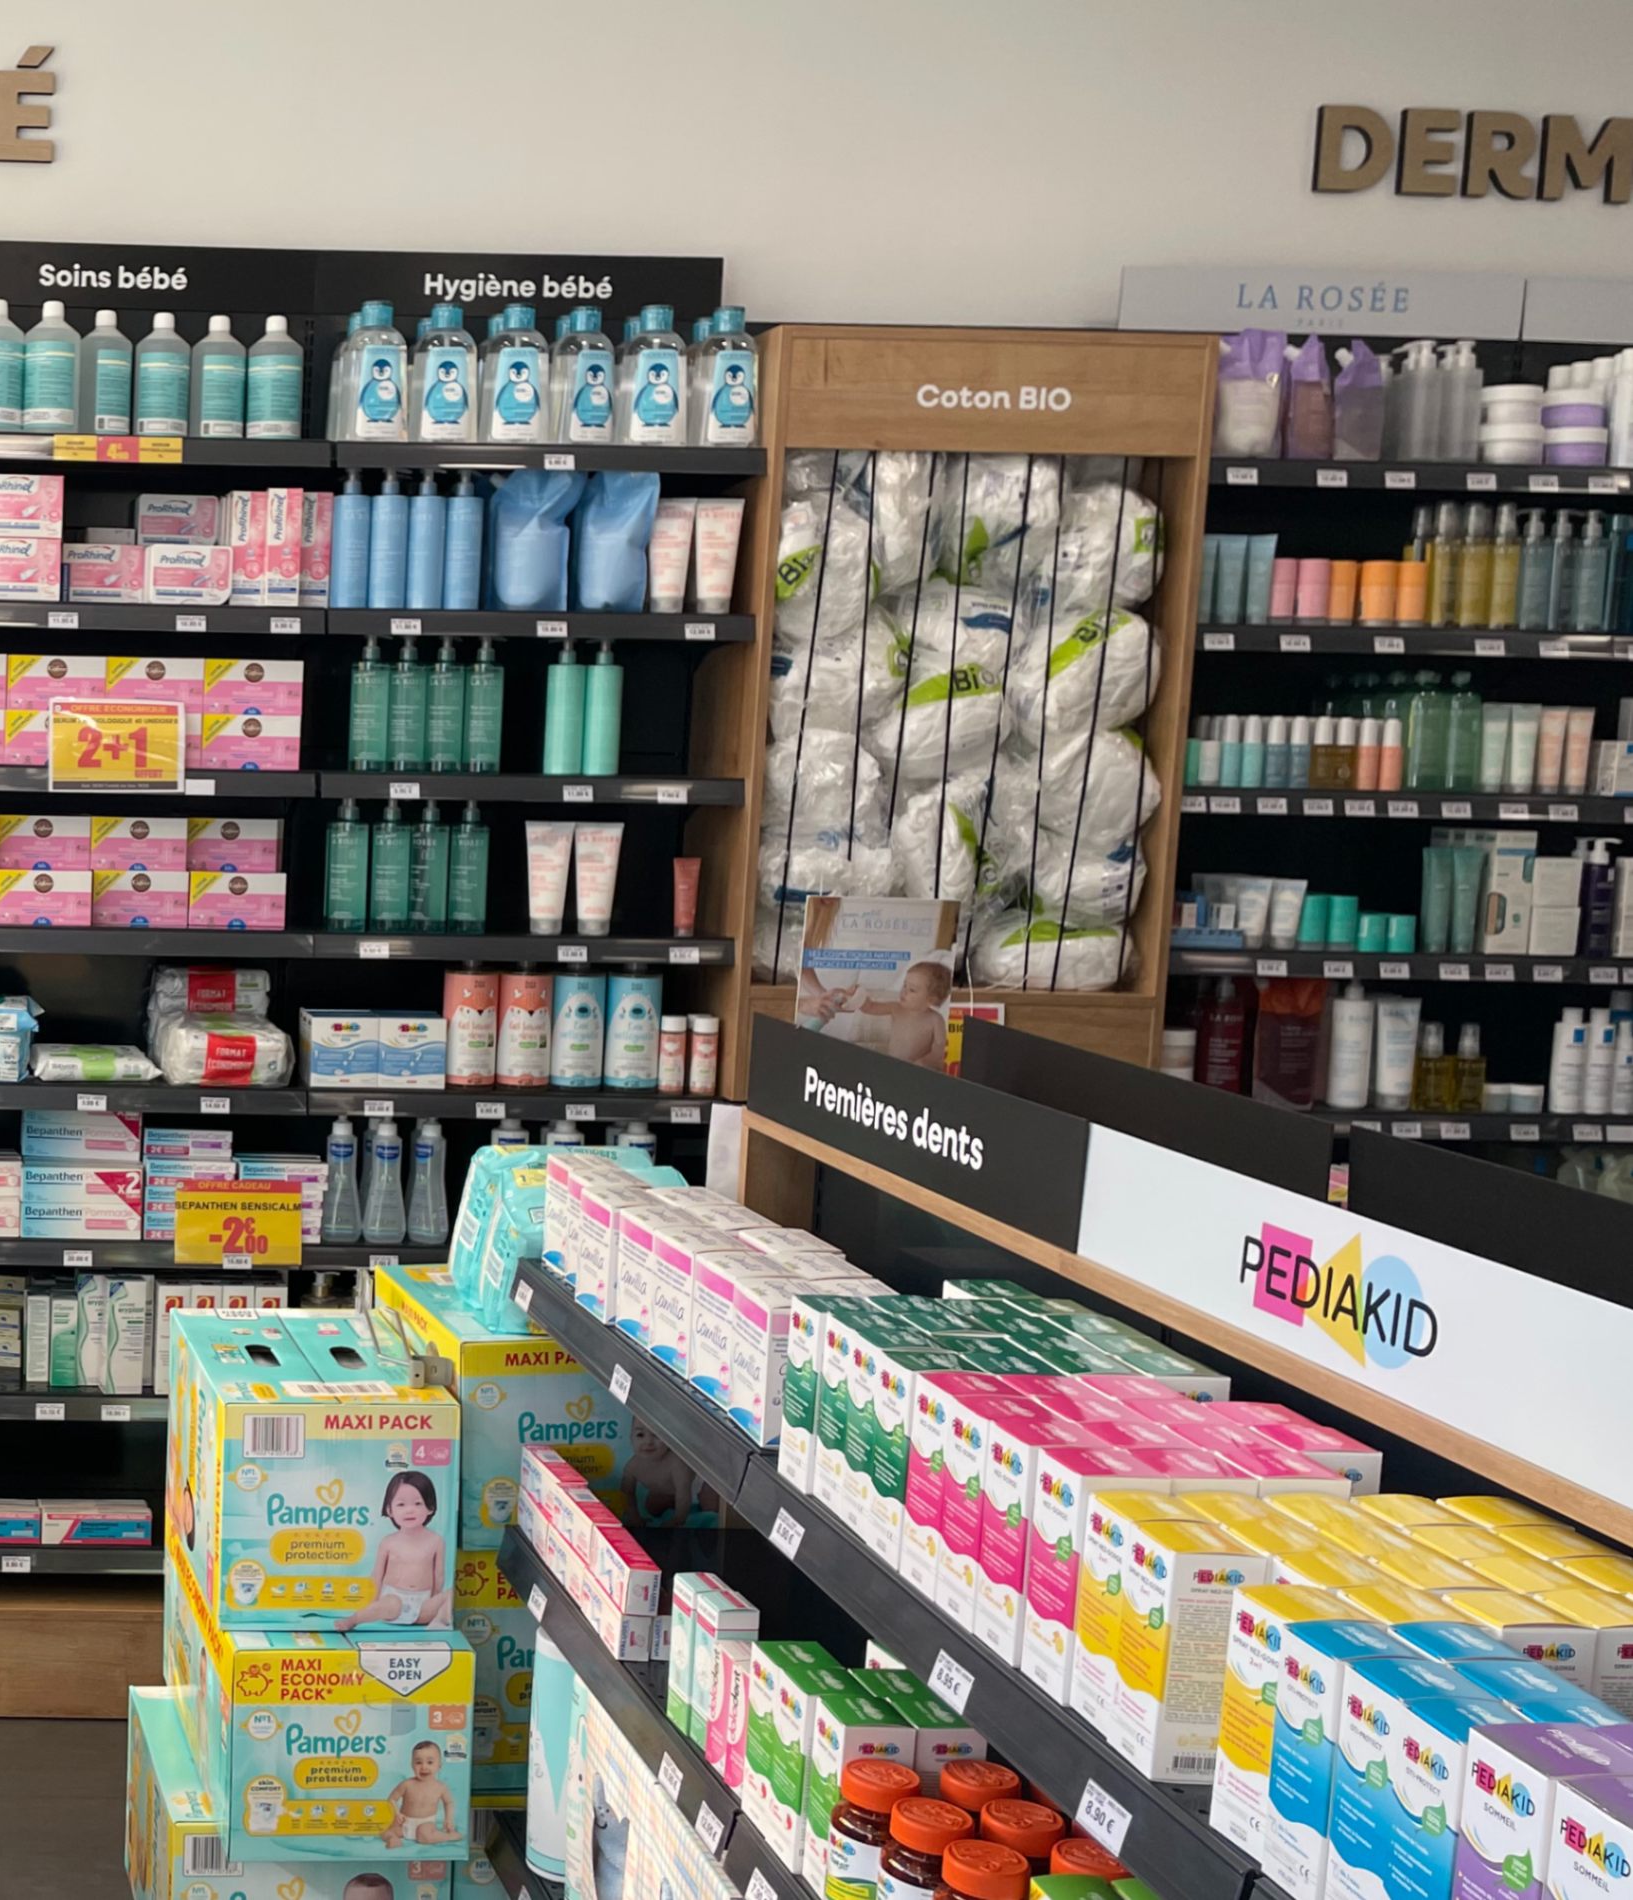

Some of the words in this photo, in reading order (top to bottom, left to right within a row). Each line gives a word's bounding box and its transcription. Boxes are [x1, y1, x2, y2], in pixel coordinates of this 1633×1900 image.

[38, 264, 111, 289] Soins
[118, 266, 188, 290] bébé
[424, 273, 536, 302] Hygiène
[543, 275, 613, 299] bébé
[1236, 283, 1279, 311] LA
[1296, 282, 1411, 314] ROSÉE
[917, 384, 1012, 411] Coton
[1019, 386, 1073, 412] BIO
[78, 727, 148, 768] 2+1
[216, 1047, 246, 1058] FORMAT
[26, 1125, 82, 1137] Bepanthen
[804, 1067, 908, 1140] Premières
[912, 1108, 985, 1171] dents
[25, 1170, 83, 1182] Bepanthen
[117, 1172, 141, 1195] x2
[198, 1181, 229, 1190] OFFRE
[232, 1182, 271, 1191] CADEAU
[24, 1206, 82, 1217] Bepanthen
[175, 1201, 238, 1210] BEPANTHEN
[241, 1202, 302, 1211] SENSICALM
[1240, 1235, 1438, 1357] PEDIAKID
[505, 1352, 549, 1366] MAXI
[324, 1415, 372, 1429] MAXI
[379, 1415, 432, 1429] PACK
[518, 1412, 618, 1444] Pampers
[415, 1446, 425, 1457] 4
[991, 1441, 1024, 1476] PEDIAKID
[1039, 1471, 1074, 1507] PEDIAKID
[266, 1493, 370, 1529] Pampers
[1091, 1512, 1123, 1547] PEDIAKID
[285, 1550, 350, 1562] protection
[290, 1539, 345, 1552] premium
[1132, 1542, 1167, 1579] PEDIAKID
[1193, 1569, 1245, 1584] PEDIAKID
[280, 1659, 322, 1671] MAXI
[387, 1670, 422, 1680] OPEN
[389, 1658, 420, 1668] EASY
[1284, 1655, 1325, 1694] PEDIAKID
[281, 1674, 365, 1686] ECONOMY
[936, 1668, 953, 1691] 8.95
[953, 1682, 960, 1696] €
[433, 1712, 442, 1723] 3
[1347, 1694, 1390, 1736] PEDIAKID
[286, 1723, 386, 1759] Pampers
[310, 1765, 362, 1775] premium
[1403, 1737, 1449, 1780] PEDIAKID
[305, 1774, 367, 1784] protection
[1471, 1760, 1536, 1817] PEDIAKID
[1085, 1800, 1106, 1827] 8.90
[1106, 1818, 1116, 1835] €
[1483, 1802, 1517, 1831] SOMMEIL
[1559, 1817, 1631, 1878] PEDIAKID
[1572, 1861, 1610, 1893] SOMMEIL
